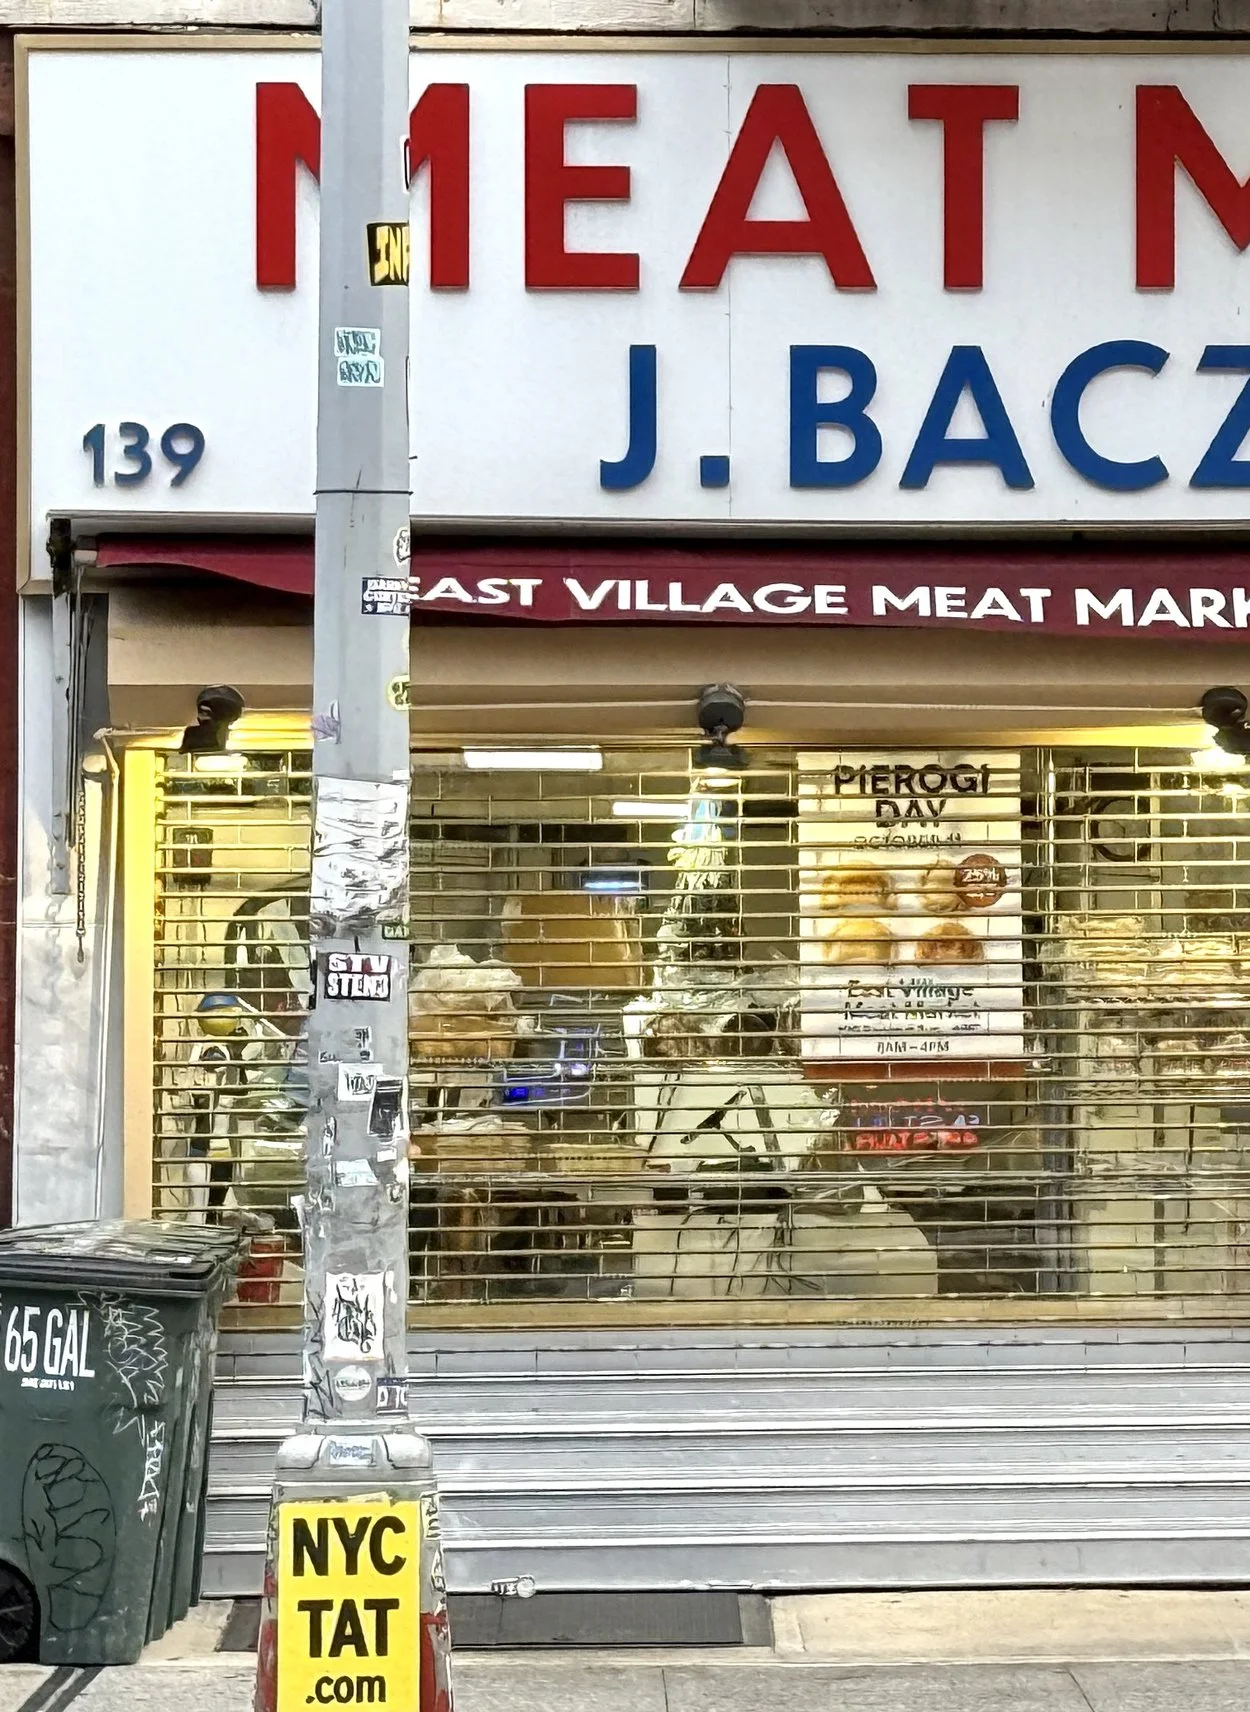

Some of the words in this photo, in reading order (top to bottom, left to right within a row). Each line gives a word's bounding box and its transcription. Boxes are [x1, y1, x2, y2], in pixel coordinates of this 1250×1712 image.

[256, 82, 1018, 290] MEAT
[599, 344, 731, 490] J.
[83, 423, 205, 487] 139
[562, 578, 848, 615] VILLAGE
[872, 585, 1052, 623] MEAT
[834, 764, 990, 794] PIEROGI
[4, 1305, 41, 1374] 65
[43, 1308, 96, 1378] GAL
[292, 1515, 407, 1577] NYC
[297, 1598, 400, 1658] TAT
[305, 1675, 387, 1704] .com
